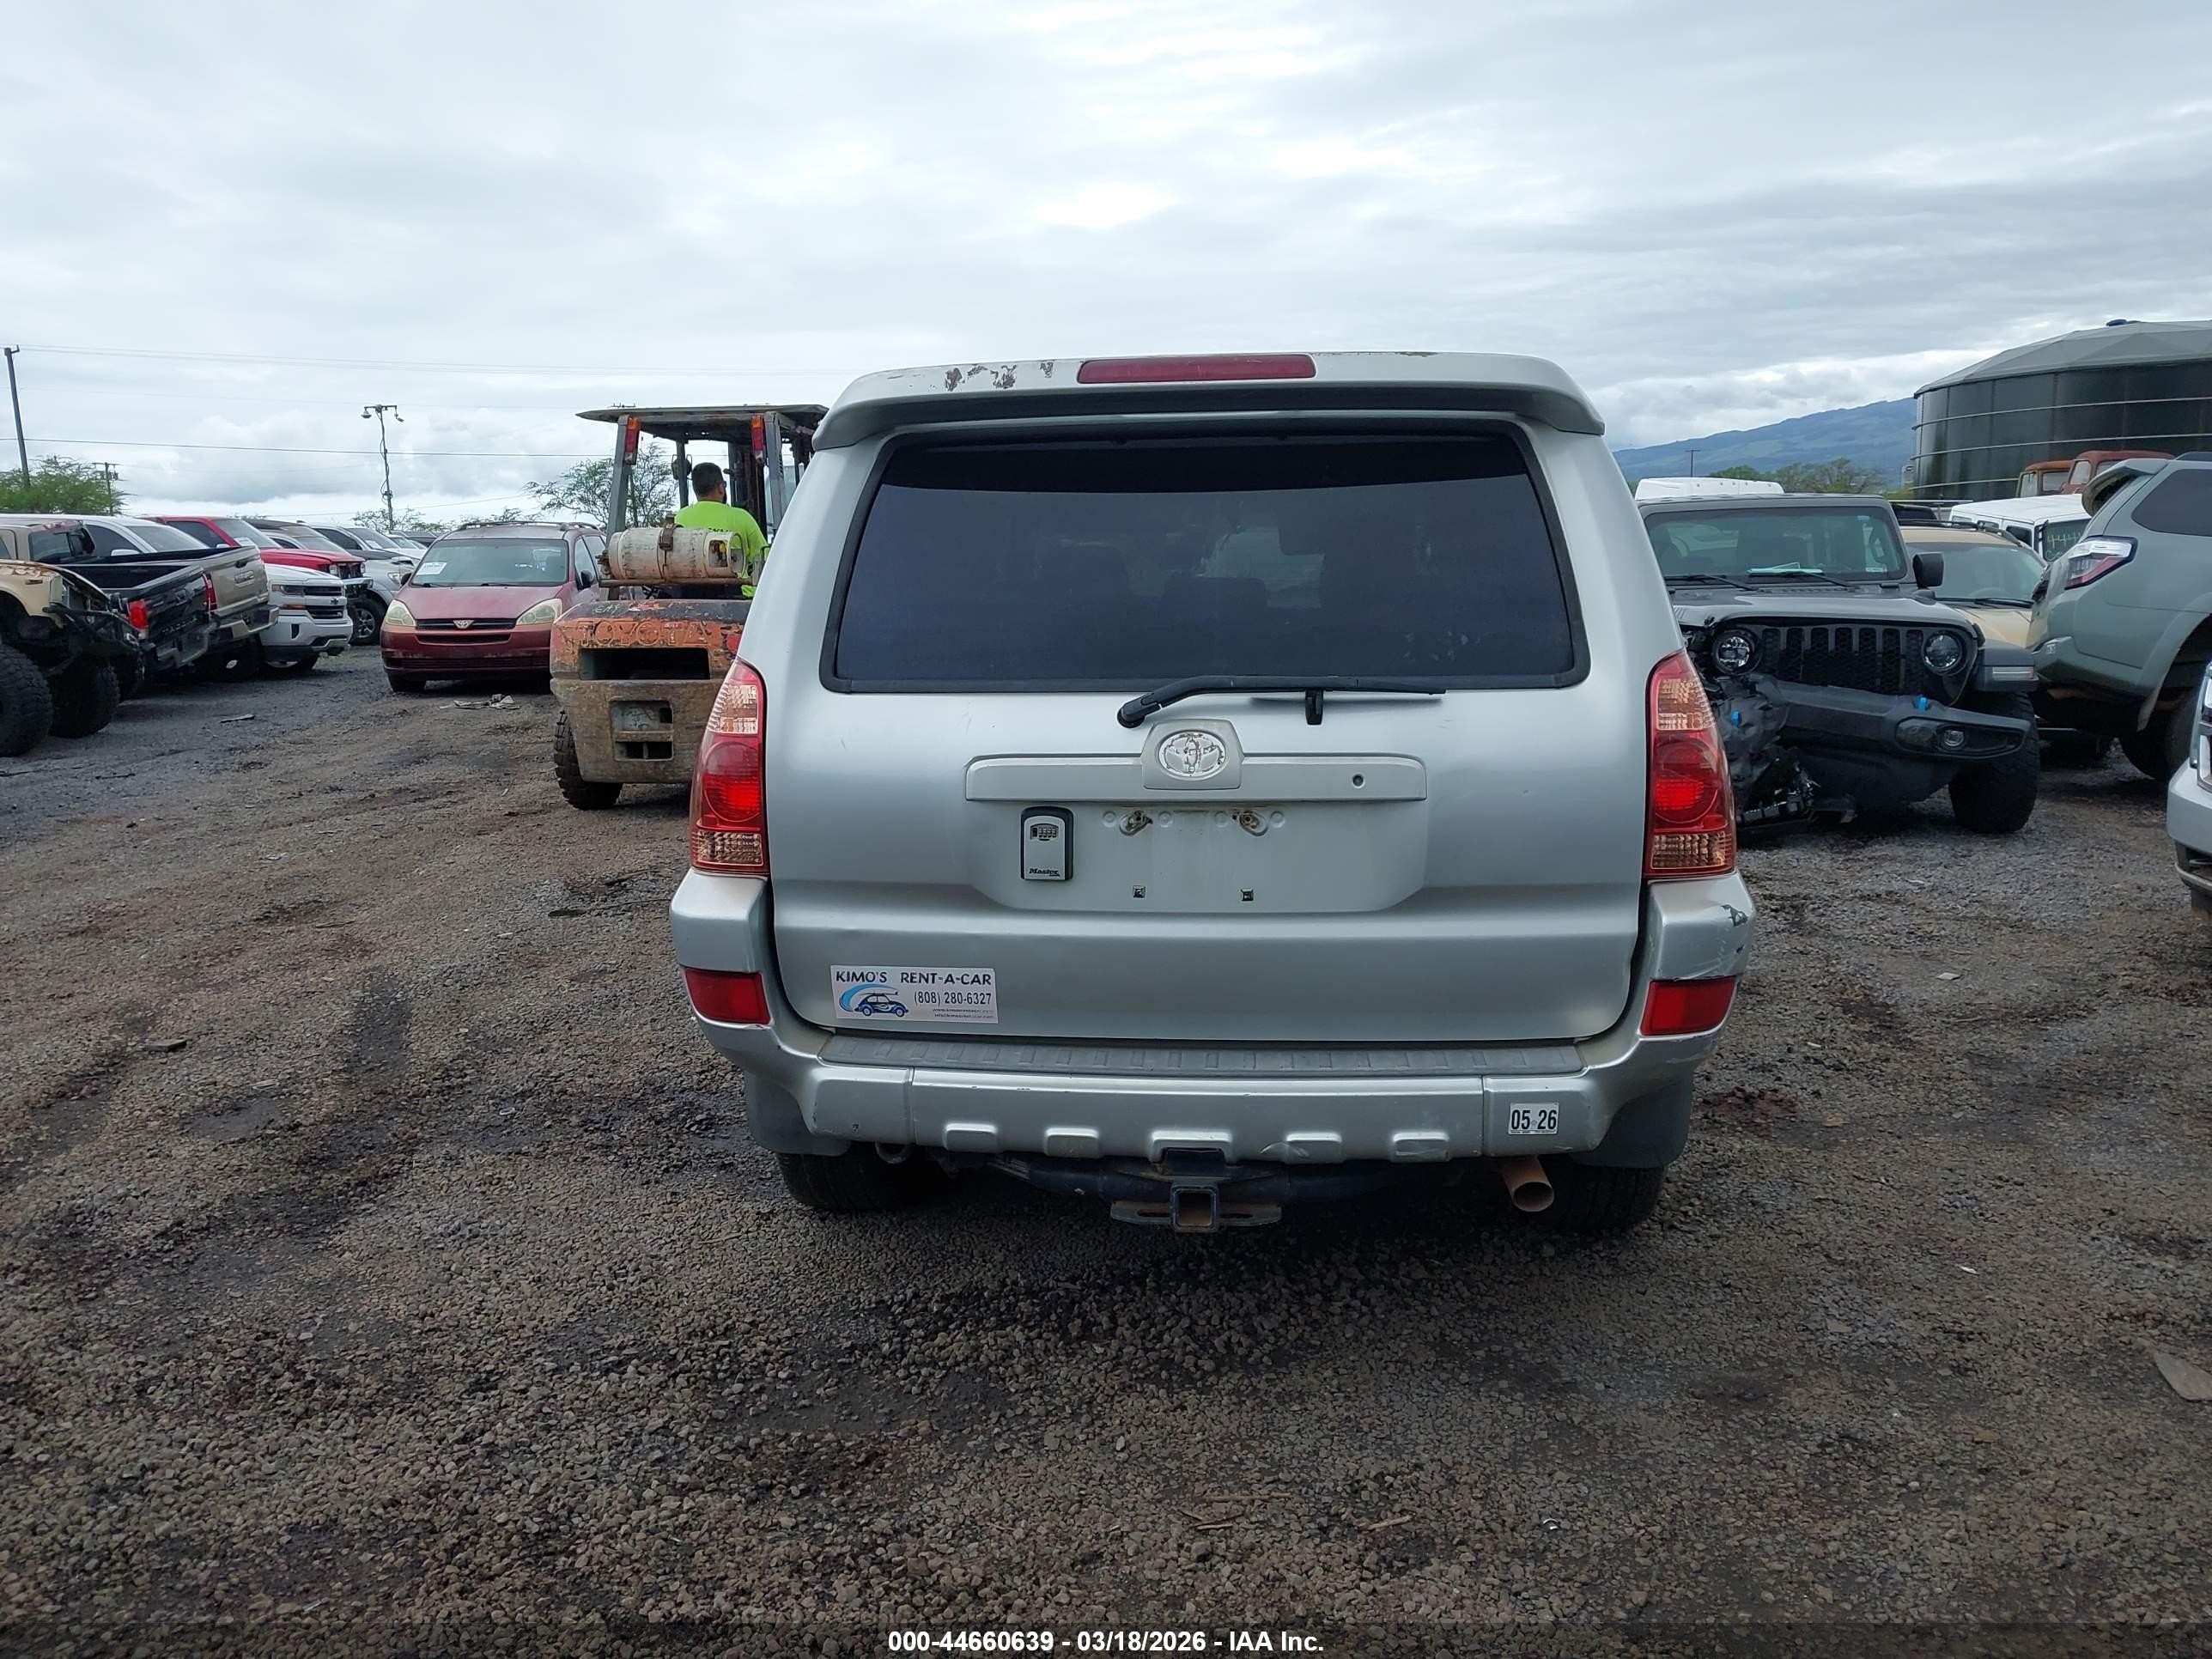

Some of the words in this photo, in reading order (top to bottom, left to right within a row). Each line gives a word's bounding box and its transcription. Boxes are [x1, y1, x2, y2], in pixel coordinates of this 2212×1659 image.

[577, 620, 710, 646] TOYOTA
[836, 971, 887, 983] KIMO'S
[901, 972, 992, 985] RENT-A-CAR
[914, 991, 941, 1007] (808)
[944, 992, 992, 1005] 280-6327
[1511, 1109, 1531, 1130] 05
[1537, 1109, 1558, 1130] 26
